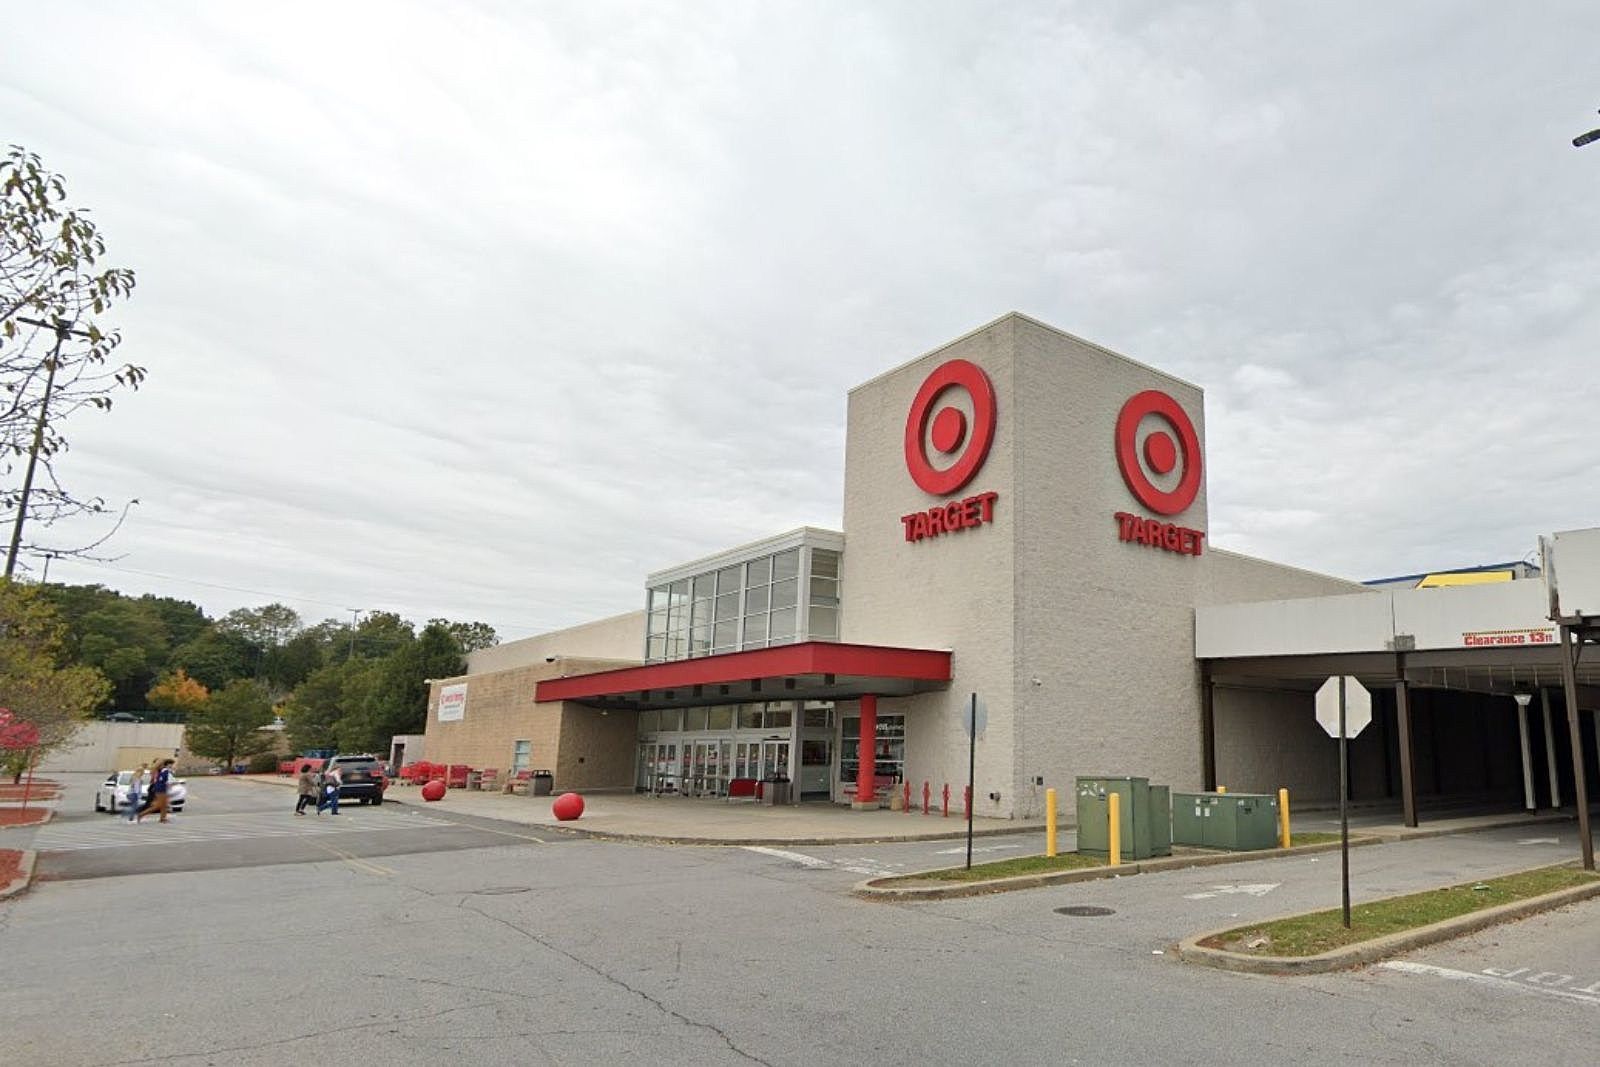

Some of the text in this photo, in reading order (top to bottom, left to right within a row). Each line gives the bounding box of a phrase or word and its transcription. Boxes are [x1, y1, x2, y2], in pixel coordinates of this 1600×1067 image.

[902, 492, 997, 543] TARGET
[1115, 512, 1205, 556] TARGET
[1464, 634, 1525, 646] Clearance
